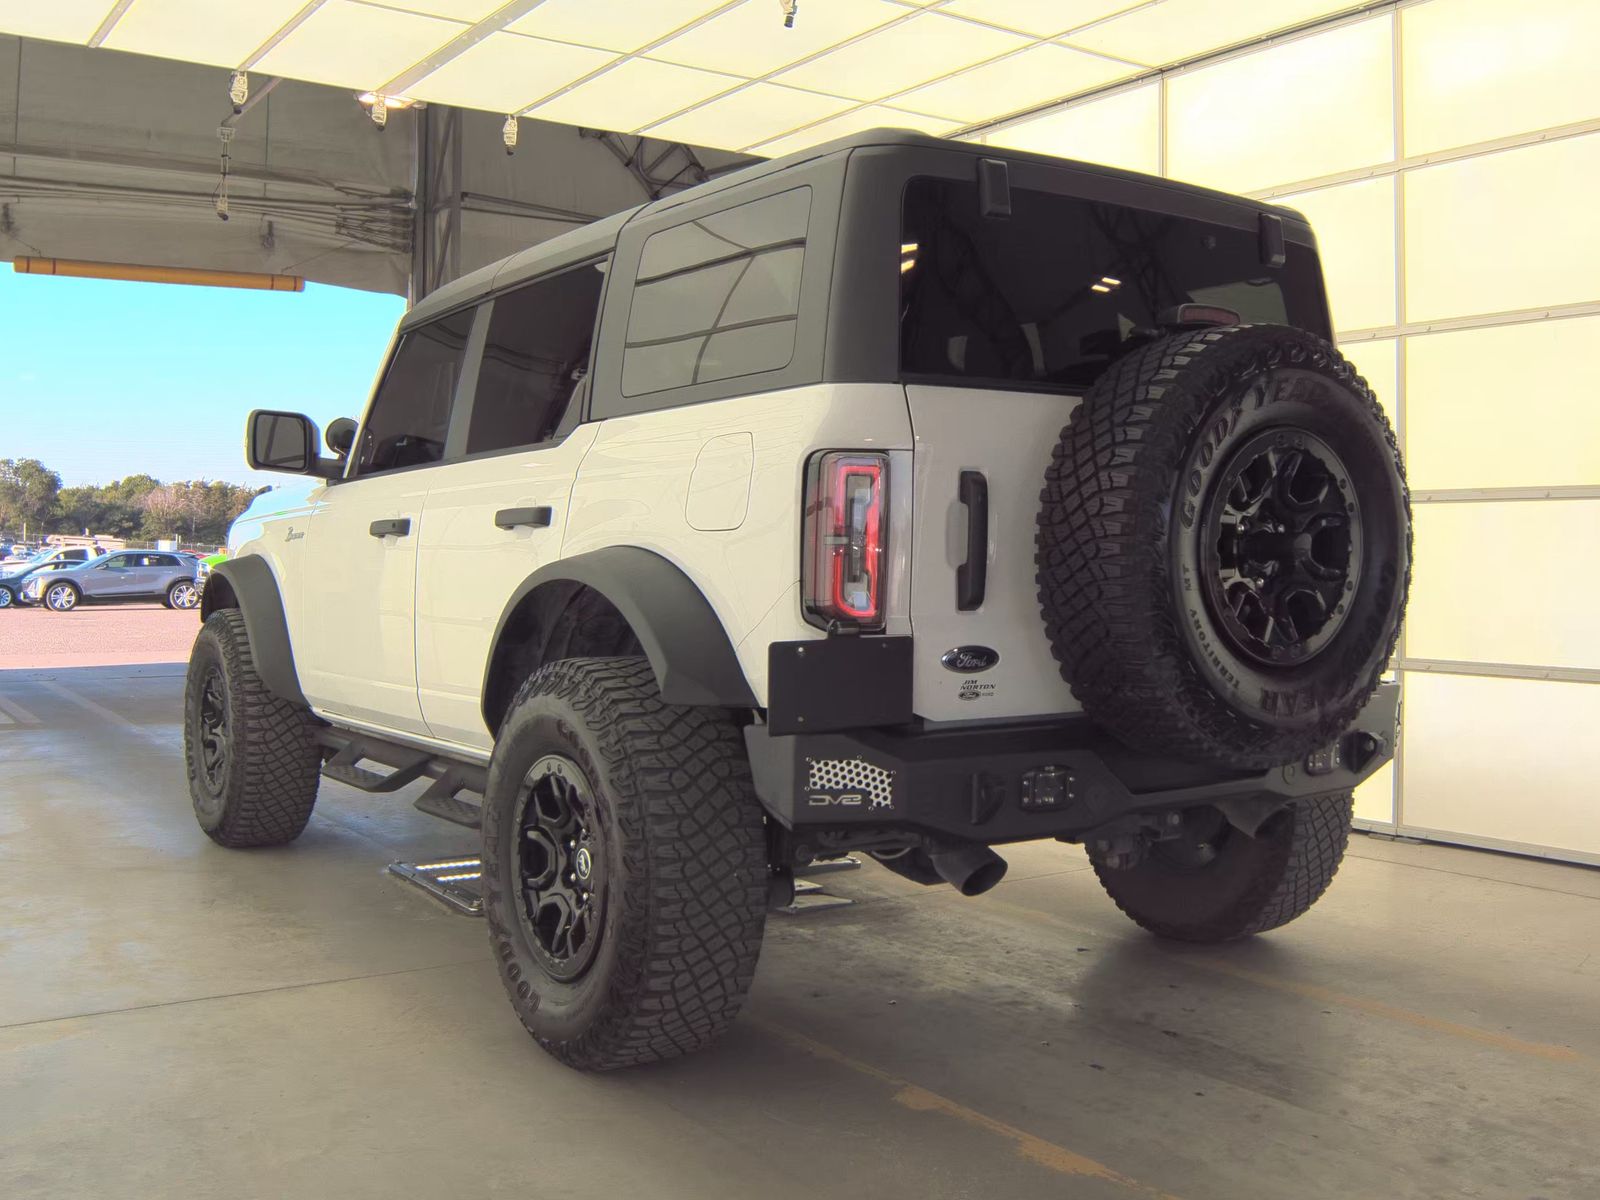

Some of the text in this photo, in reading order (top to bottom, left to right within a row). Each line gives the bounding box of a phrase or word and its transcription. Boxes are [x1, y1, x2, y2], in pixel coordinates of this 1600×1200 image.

[956, 653, 986, 667] Ford
[1183, 564, 1241, 689] TERRITORY MT
